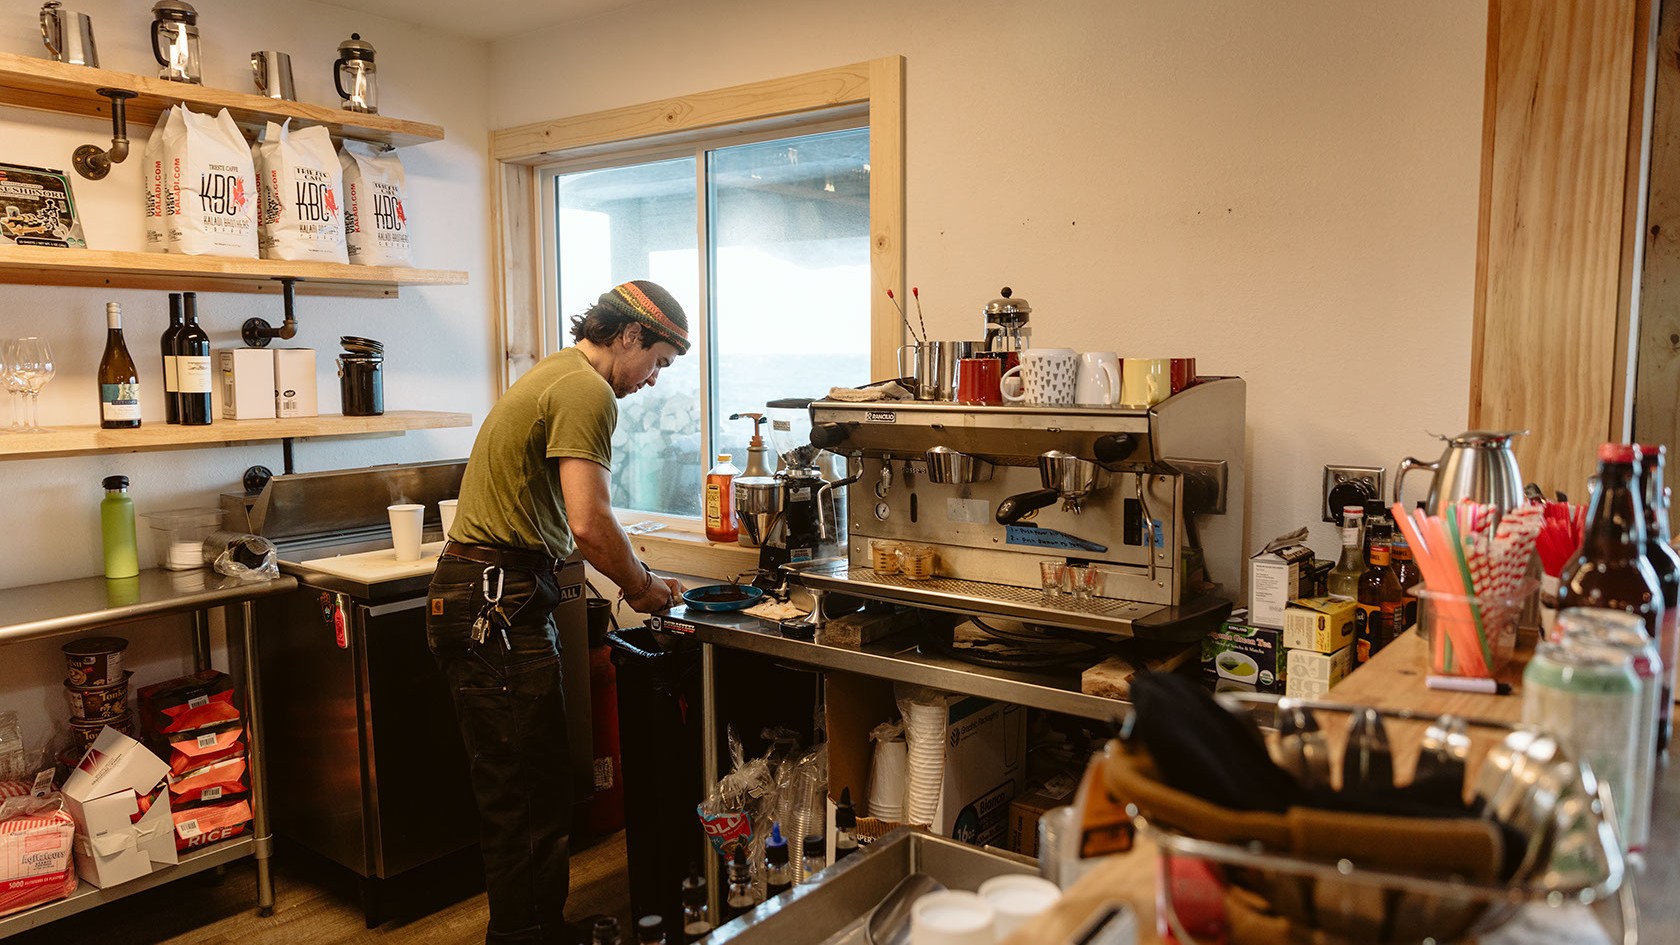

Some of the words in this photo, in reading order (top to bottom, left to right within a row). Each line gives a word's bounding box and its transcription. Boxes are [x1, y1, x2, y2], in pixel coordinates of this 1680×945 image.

[173, 158, 181, 215] KALADI.COM
[199, 173, 237, 216] KBC
[296, 181, 330, 222] KBC
[350, 183, 361, 232] KALADI.COM
[374, 194, 401, 231] KBC
[1233, 635, 1256, 646] Green
[1256, 638, 1272, 649] Tea
[188, 827, 233, 847] RICE
[703, 814, 742, 835] OLO
